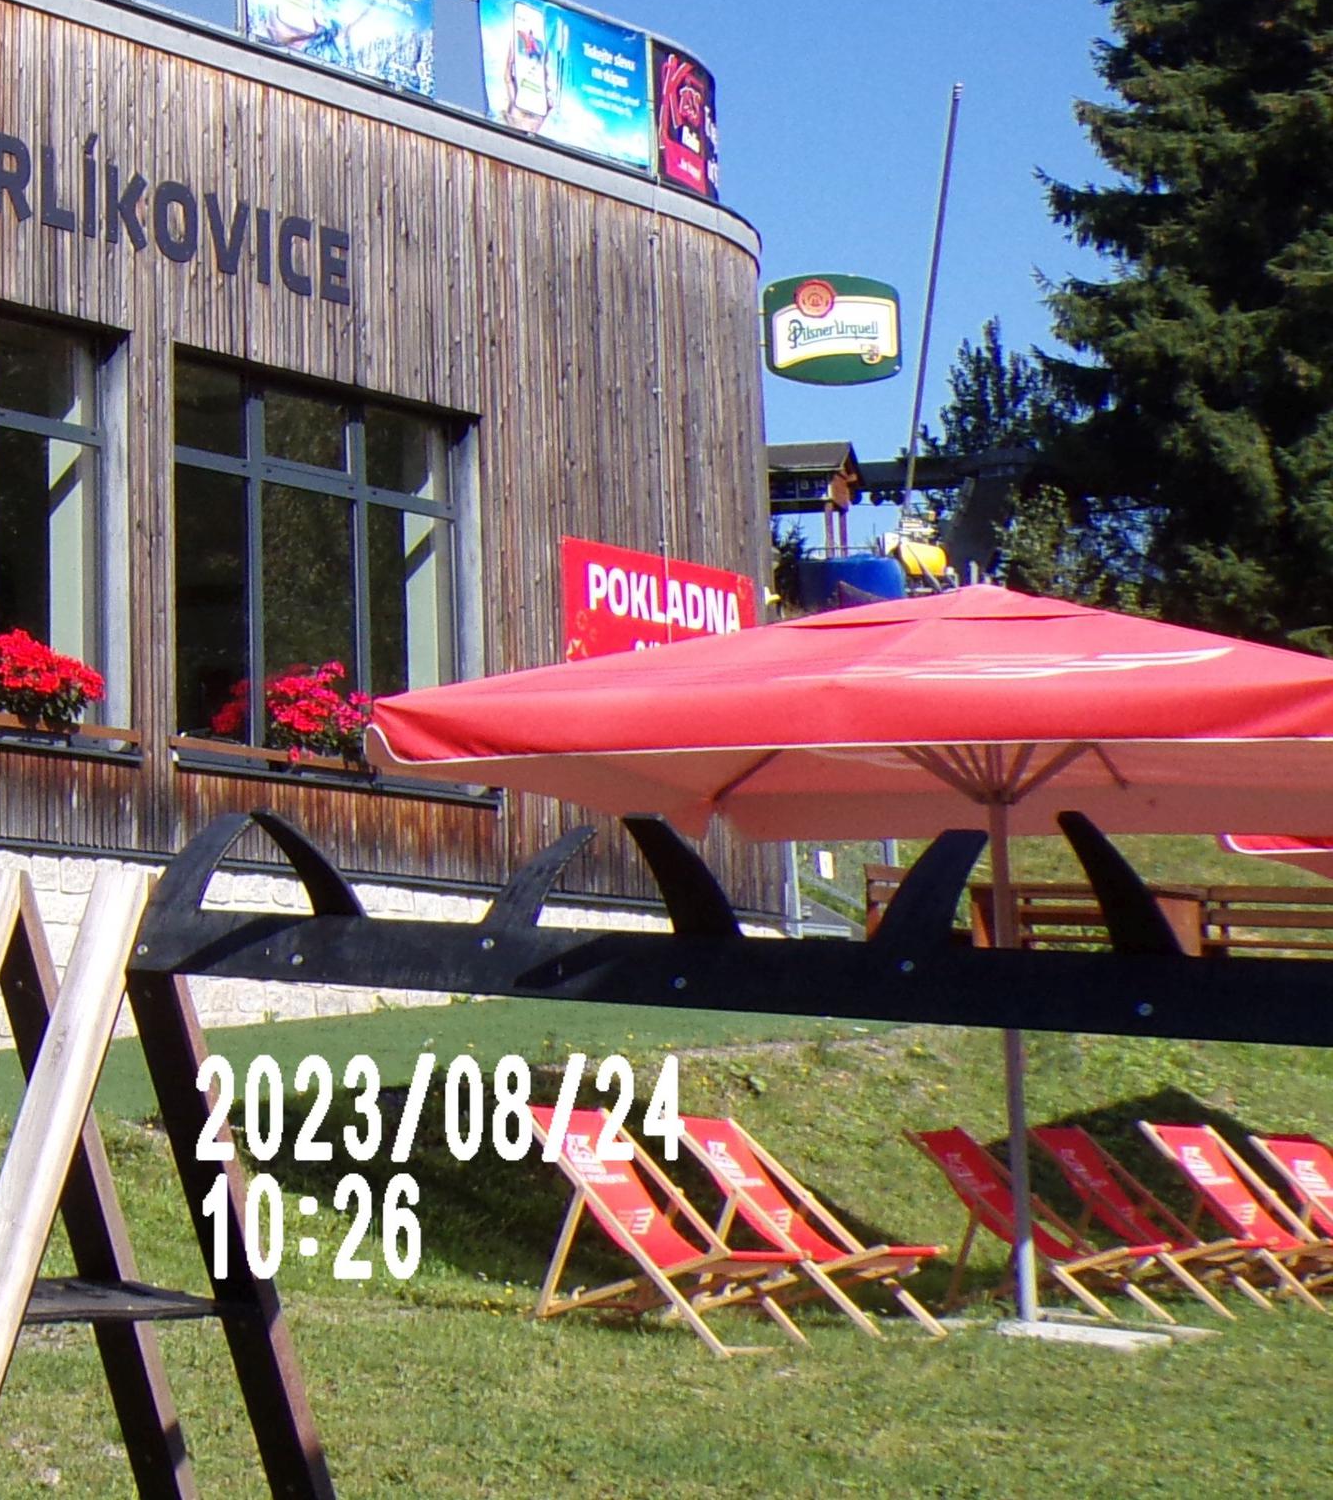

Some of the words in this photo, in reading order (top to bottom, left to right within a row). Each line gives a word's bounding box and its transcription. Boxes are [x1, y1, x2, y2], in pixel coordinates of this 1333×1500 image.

[787, 319, 835, 350] Pilsner
[834, 319, 879, 340] Urquell
[587, 562, 741, 636] POKLADNA
